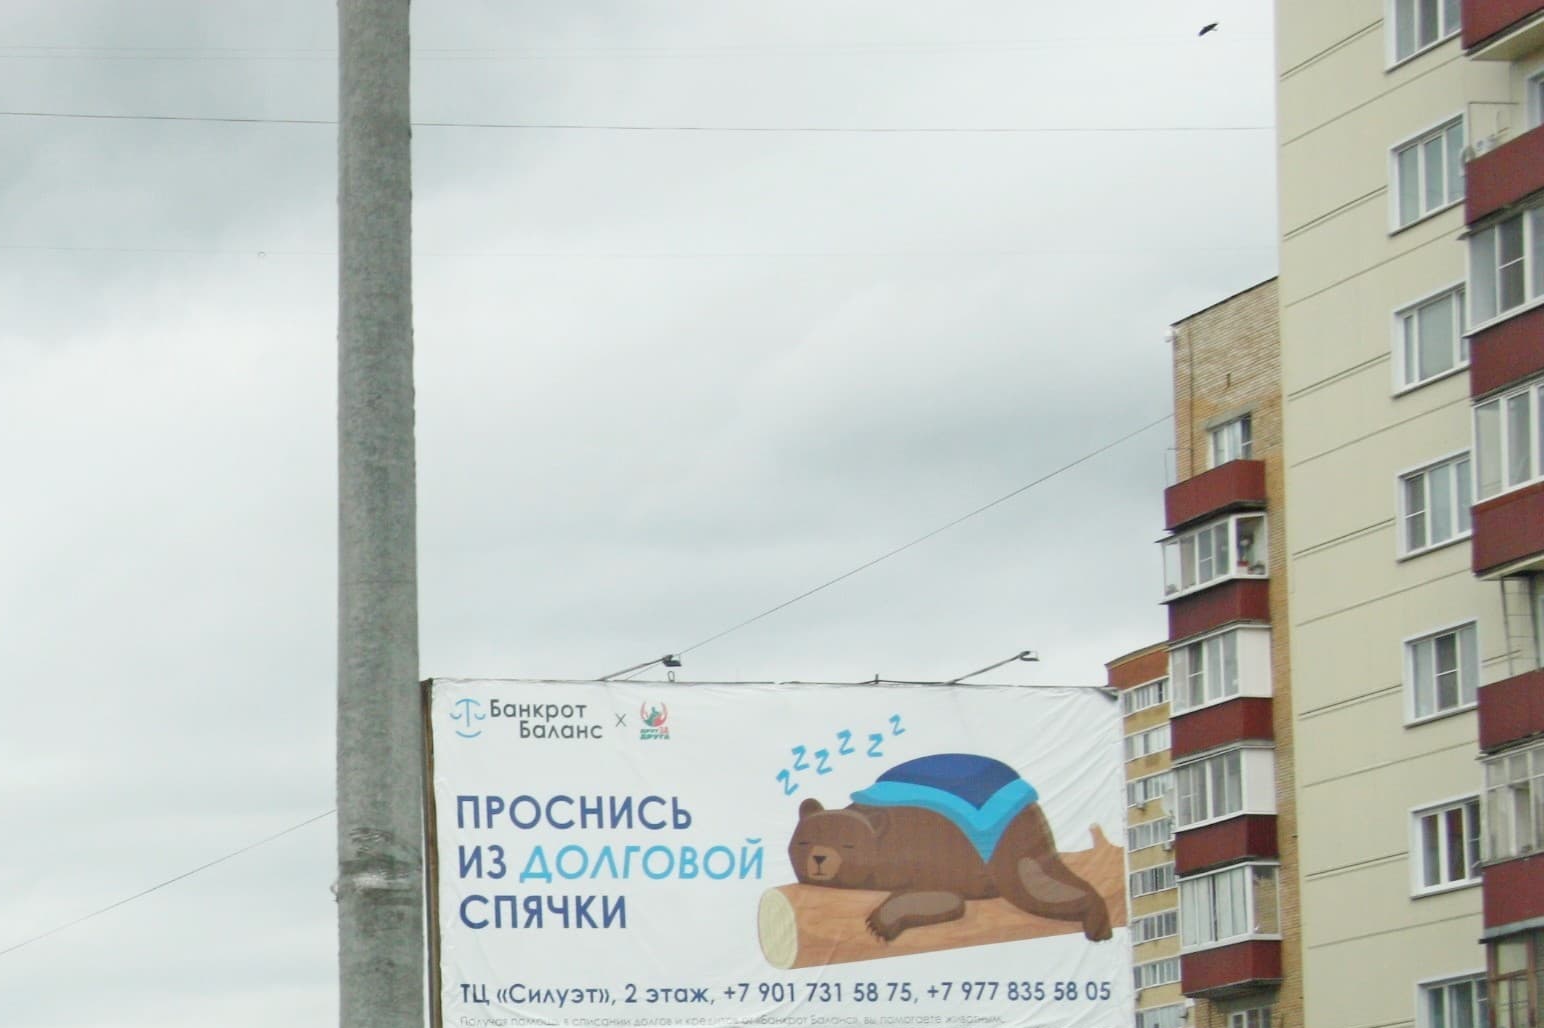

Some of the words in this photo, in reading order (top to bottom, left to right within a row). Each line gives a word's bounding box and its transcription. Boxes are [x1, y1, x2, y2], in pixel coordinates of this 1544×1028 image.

[490, 698, 587, 723] Банкрот
[519, 719, 604, 740] Баланс
[456, 795, 693, 830] ПРОСНИСЬ
[459, 845, 508, 880] ИЗ
[519, 837, 764, 885] ДОЛГОВОЙ
[459, 893, 628, 931] СПЯЧКИ
[460, 983, 490, 1006] ТЦ
[496, 983, 616, 1008] «Силуэт»,
[624, 983, 637, 1003] 2
[646, 987, 715, 1006] этаж,
[723, 983, 749, 1003] +7
[758, 982, 795, 1003] 901
[806, 982, 843, 1002] 731
[854, 982, 879, 1002] 58
[887, 982, 919, 1004] 75,
[927, 981, 953, 1001] +7
[961, 981, 1000, 1001] 977
[1007, 981, 1046, 1001] 835
[1053, 981, 1078, 1001] 58
[1085, 981, 1112, 1000] 05
